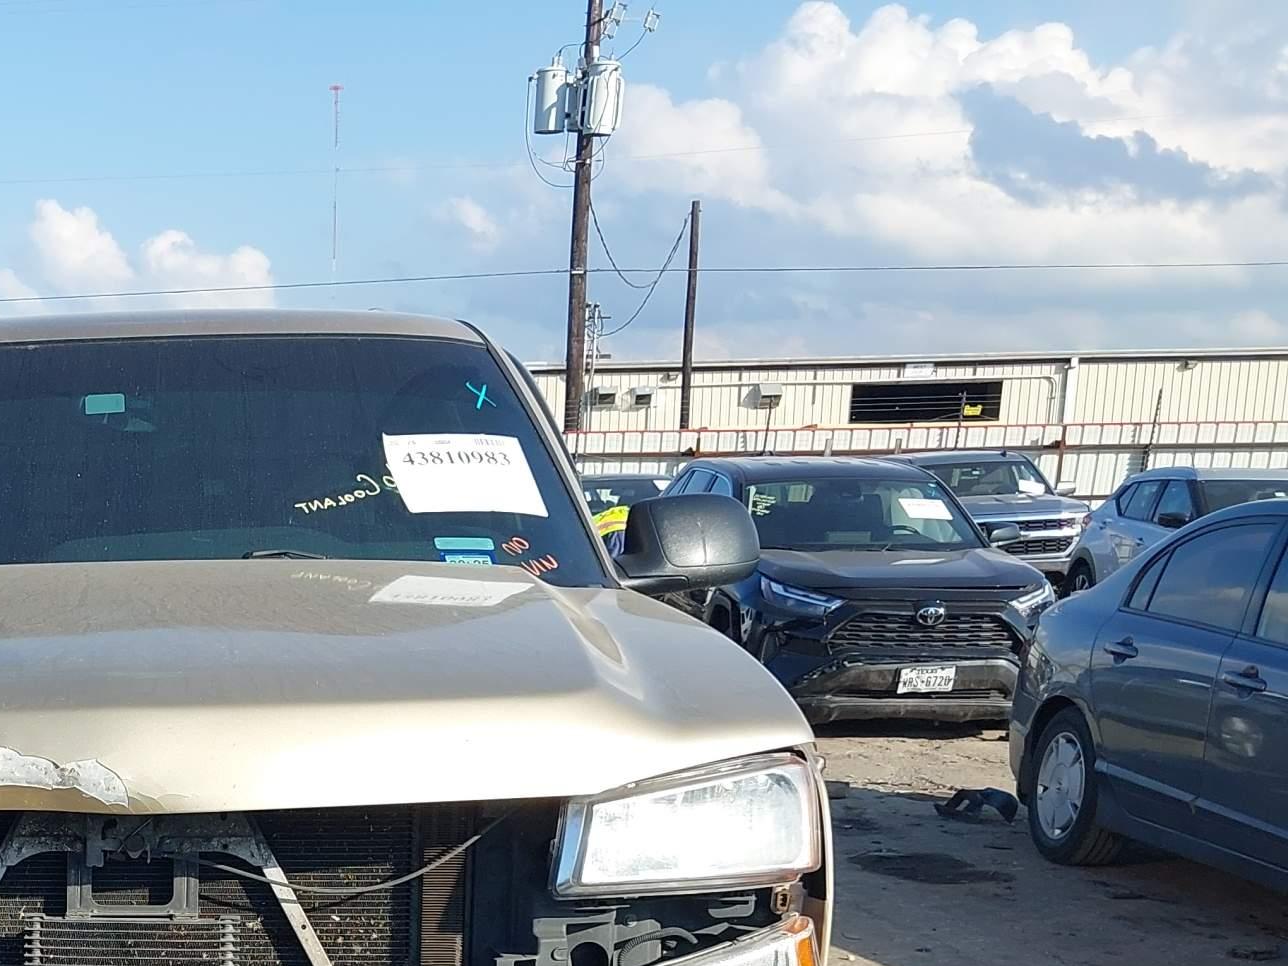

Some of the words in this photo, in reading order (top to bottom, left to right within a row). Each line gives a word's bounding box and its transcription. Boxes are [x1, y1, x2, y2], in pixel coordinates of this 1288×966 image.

[402, 451, 511, 466] 43810983
[501, 536, 530, 556] NO
[520, 553, 559, 577] VIN
